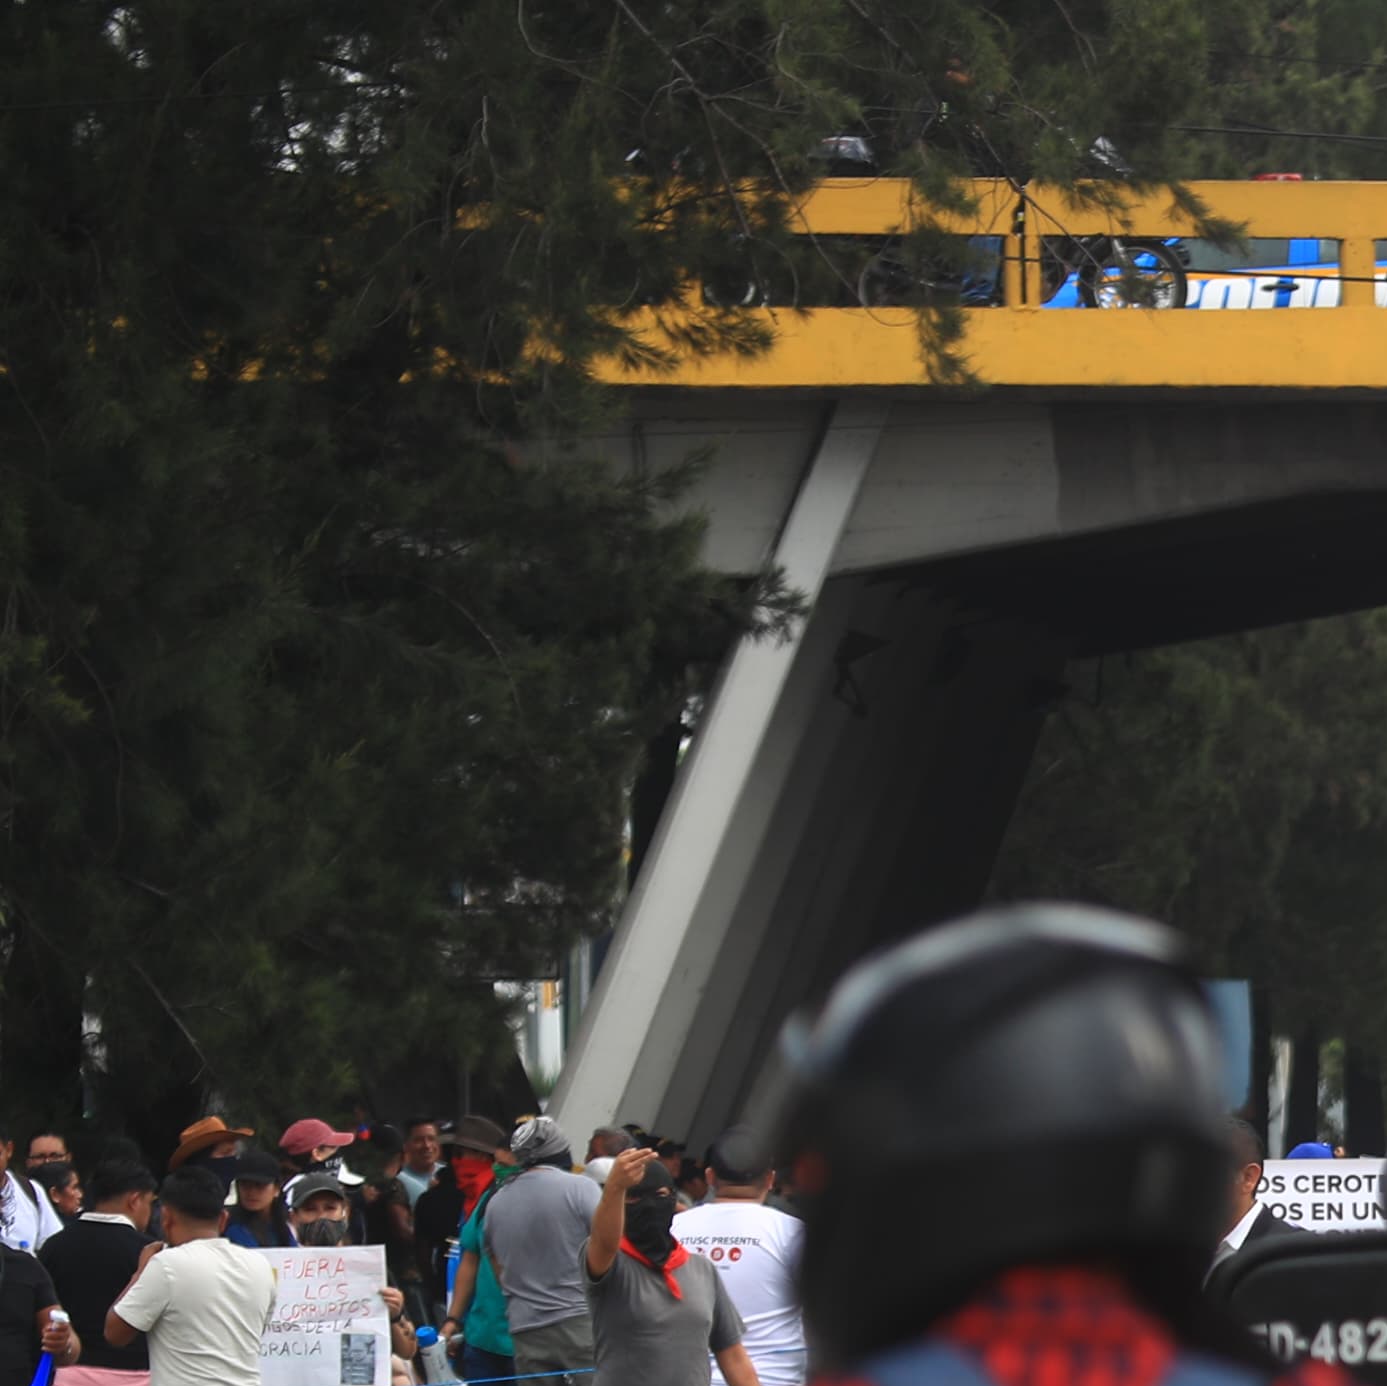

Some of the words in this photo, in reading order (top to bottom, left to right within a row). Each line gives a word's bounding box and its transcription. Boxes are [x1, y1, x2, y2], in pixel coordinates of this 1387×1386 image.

[1293, 1174, 1379, 1194] CEROT
[1311, 1202, 1344, 1221] EN
[283, 1257, 346, 1280] FUERA
[304, 1283, 349, 1301] LOS
[279, 1297, 372, 1322] CORRUPTOS
